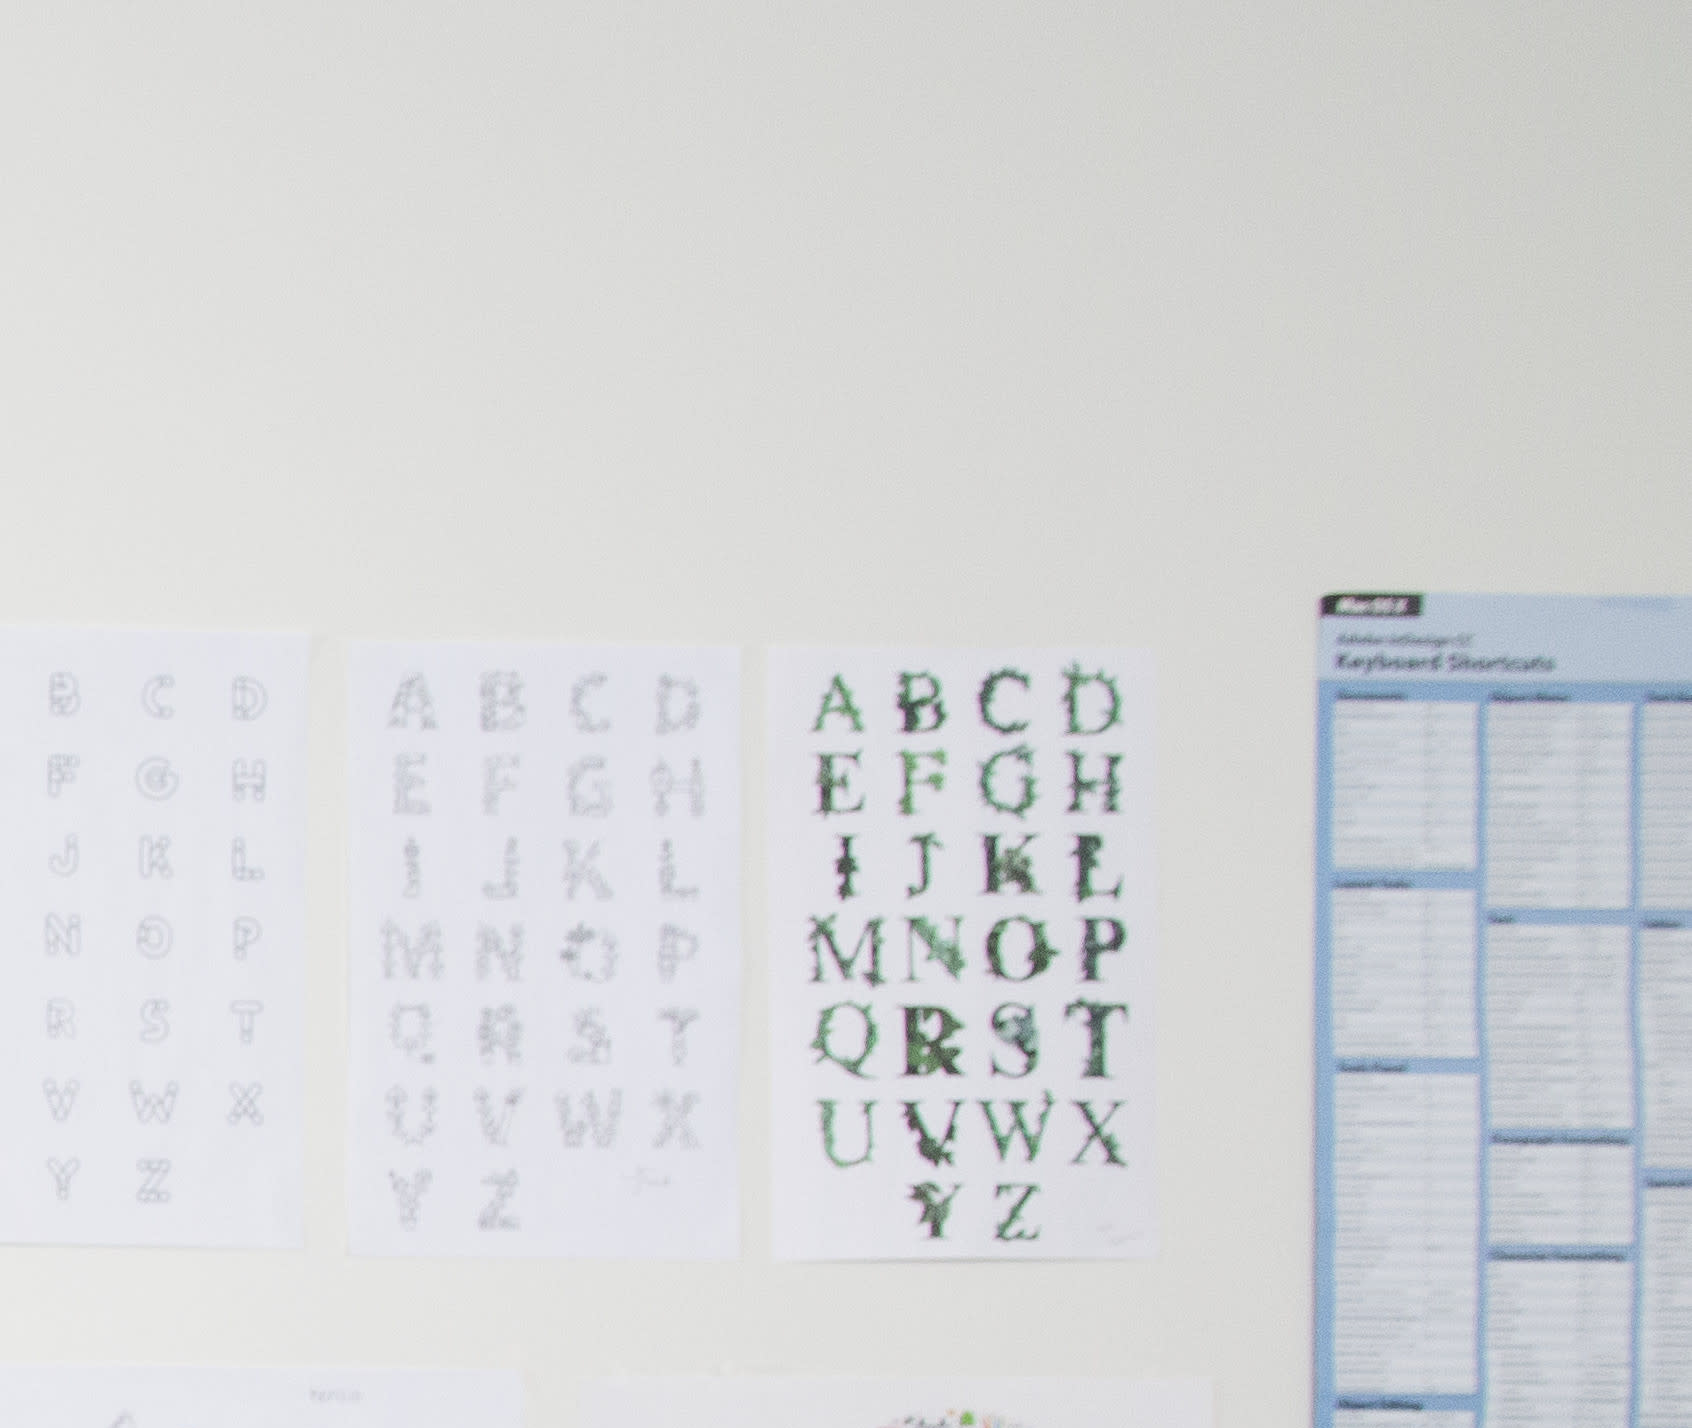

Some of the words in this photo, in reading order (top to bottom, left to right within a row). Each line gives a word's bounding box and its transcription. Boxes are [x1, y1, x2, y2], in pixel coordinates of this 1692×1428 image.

[812, 671, 864, 733] A
[897, 668, 948, 734] B
[980, 667, 1030, 734] C
[1062, 661, 1121, 737] D
[1335, 653, 1443, 673] Keyboard
[1447, 653, 1556, 672] Shortcuts
[814, 748, 865, 819] E
[898, 747, 947, 816] F
[980, 744, 1040, 818] G
[1065, 748, 1123, 816] H
[836, 833, 858, 900] I
[908, 831, 943, 899] J
[982, 833, 1041, 895] K
[1074, 833, 1123, 902] L
[809, 914, 884, 987] M
[906, 915, 965, 983] N
[987, 915, 1059, 983] O
[1081, 916, 1126, 983] P
[812, 1001, 878, 1079] Q
[900, 1005, 965, 1077] R
[991, 1002, 1041, 1079] S
[1065, 997, 1128, 1079] T
[819, 1100, 878, 1169] U
[903, 1100, 962, 1167] V
[979, 1088, 1055, 1163] W
[1071, 1100, 1126, 1167] X
[909, 1180, 963, 1241] Y
[994, 1183, 1041, 1243] Z
